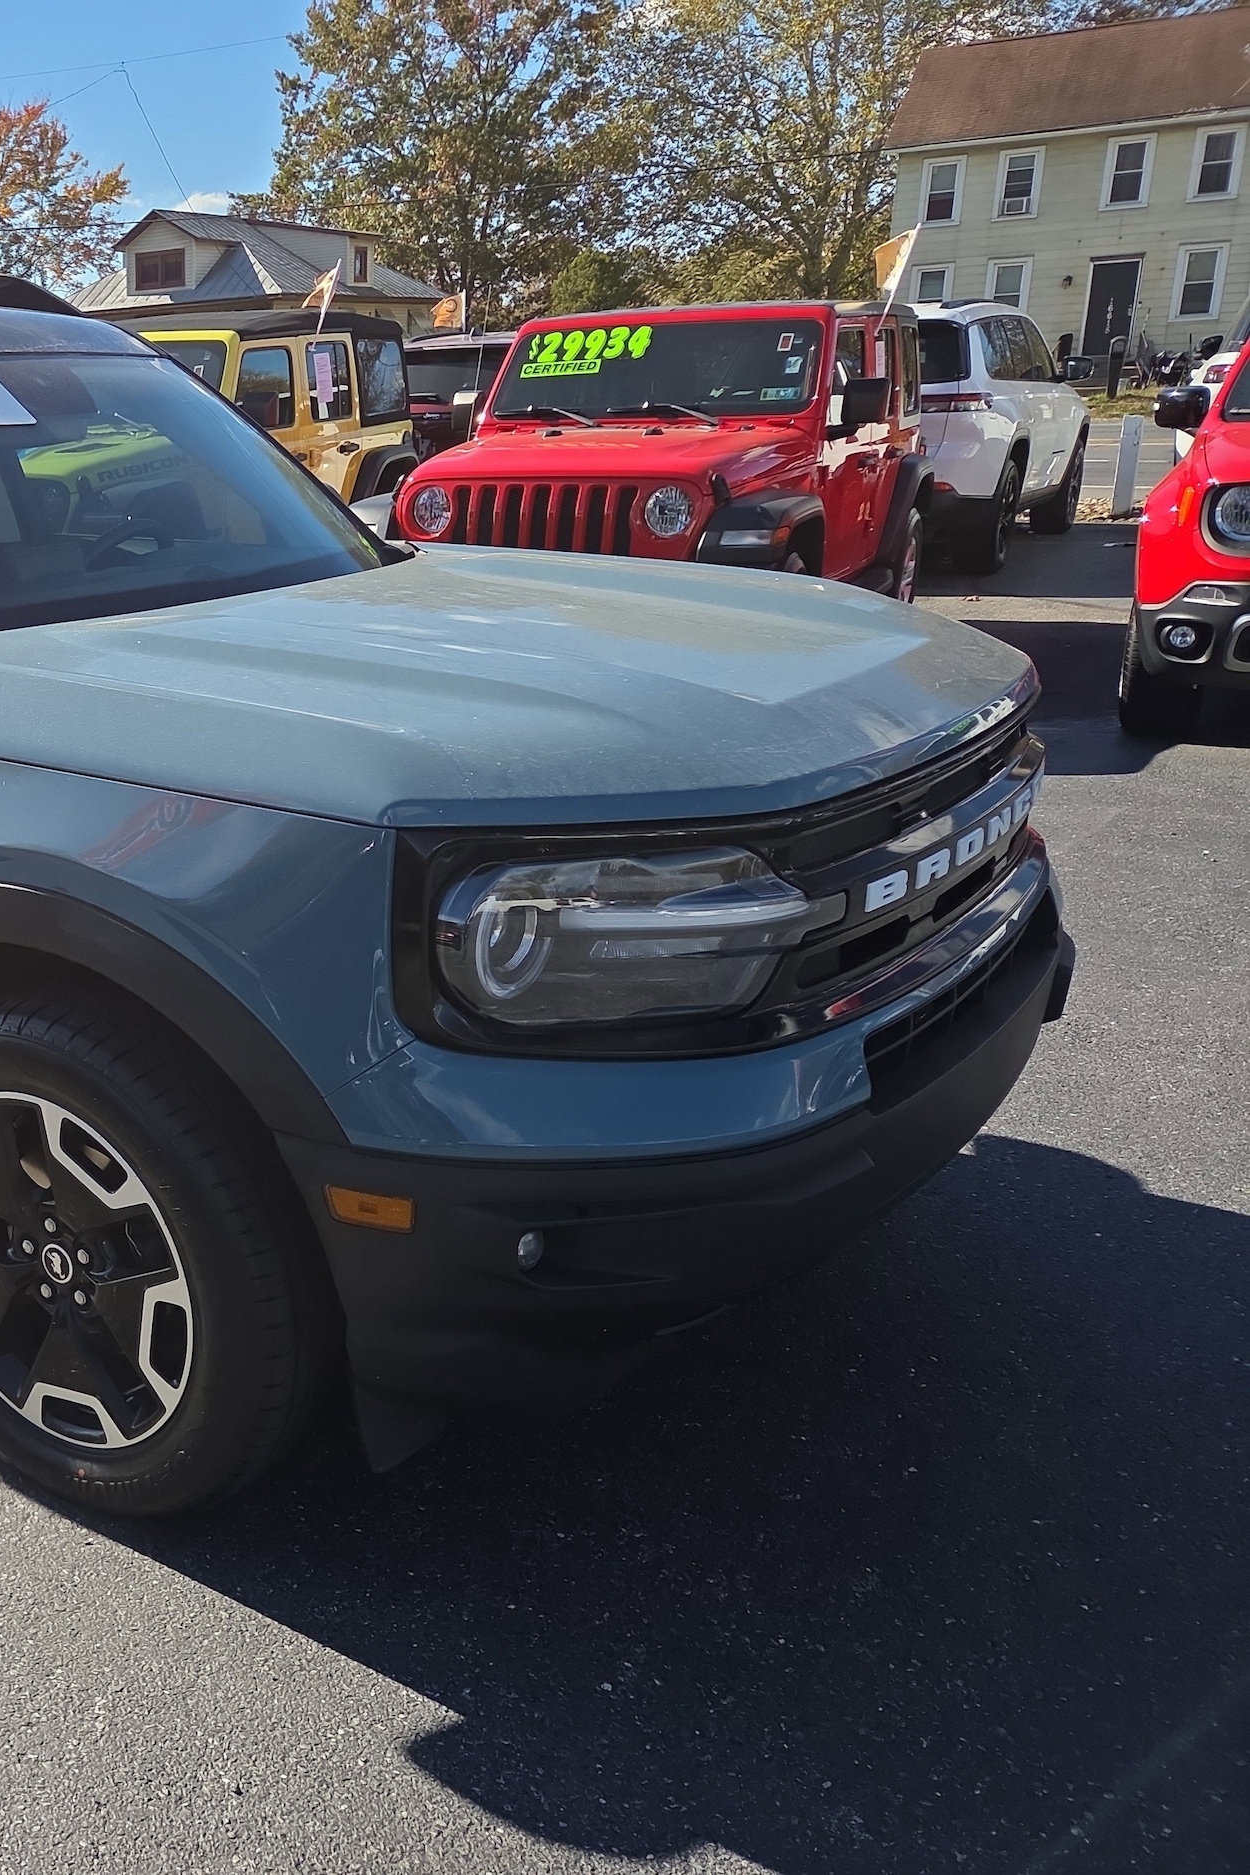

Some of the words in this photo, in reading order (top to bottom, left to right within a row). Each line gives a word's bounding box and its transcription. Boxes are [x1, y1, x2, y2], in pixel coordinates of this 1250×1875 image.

[529, 326, 653, 362] $29934
[524, 361, 597, 374] CERTIFIED
[96, 454, 189, 482] RUBICON
